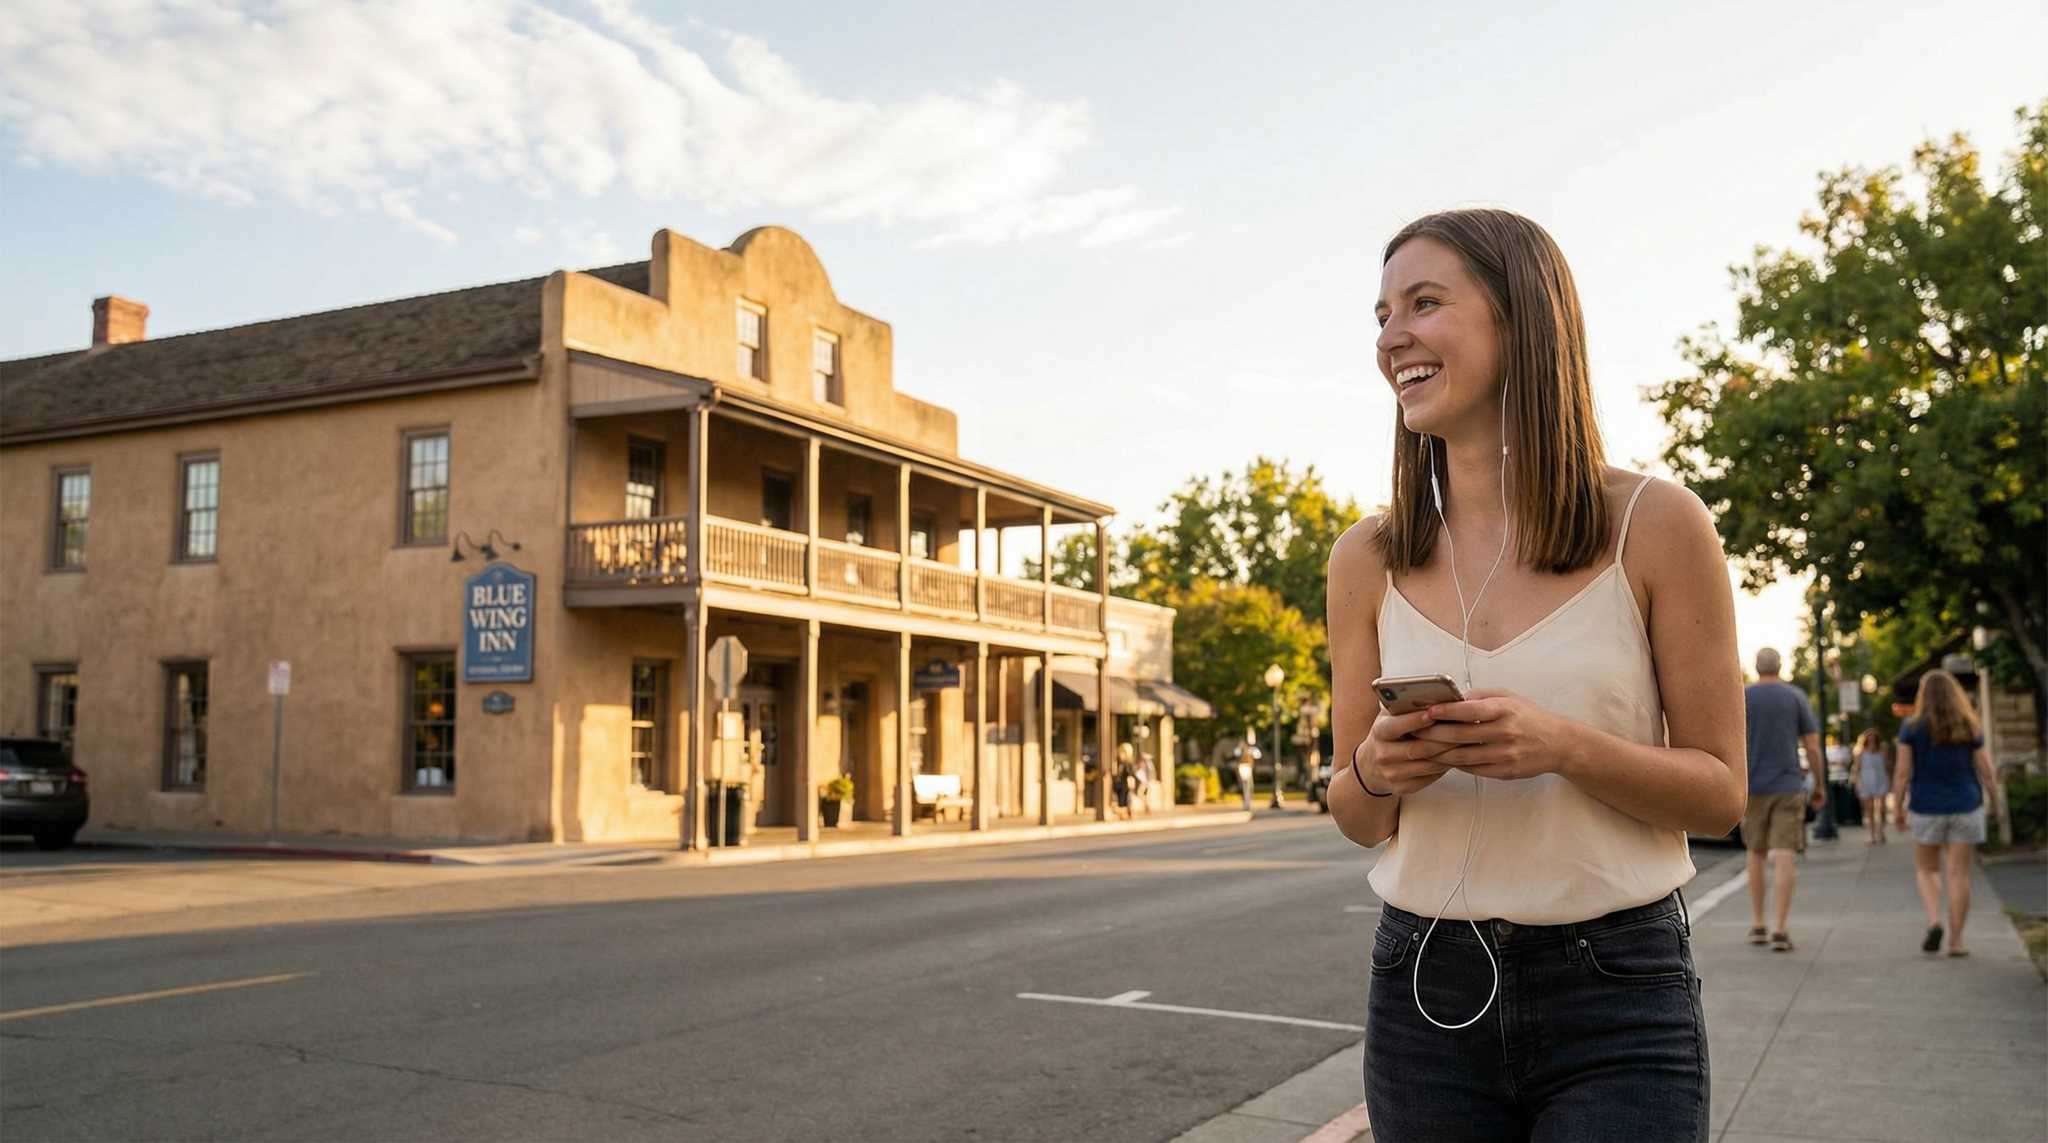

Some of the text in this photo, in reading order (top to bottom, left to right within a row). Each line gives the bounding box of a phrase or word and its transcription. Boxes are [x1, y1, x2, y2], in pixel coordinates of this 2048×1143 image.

[472, 583, 526, 607] BLUE
[469, 607, 526, 630] WING
[479, 631, 518, 653] INN
